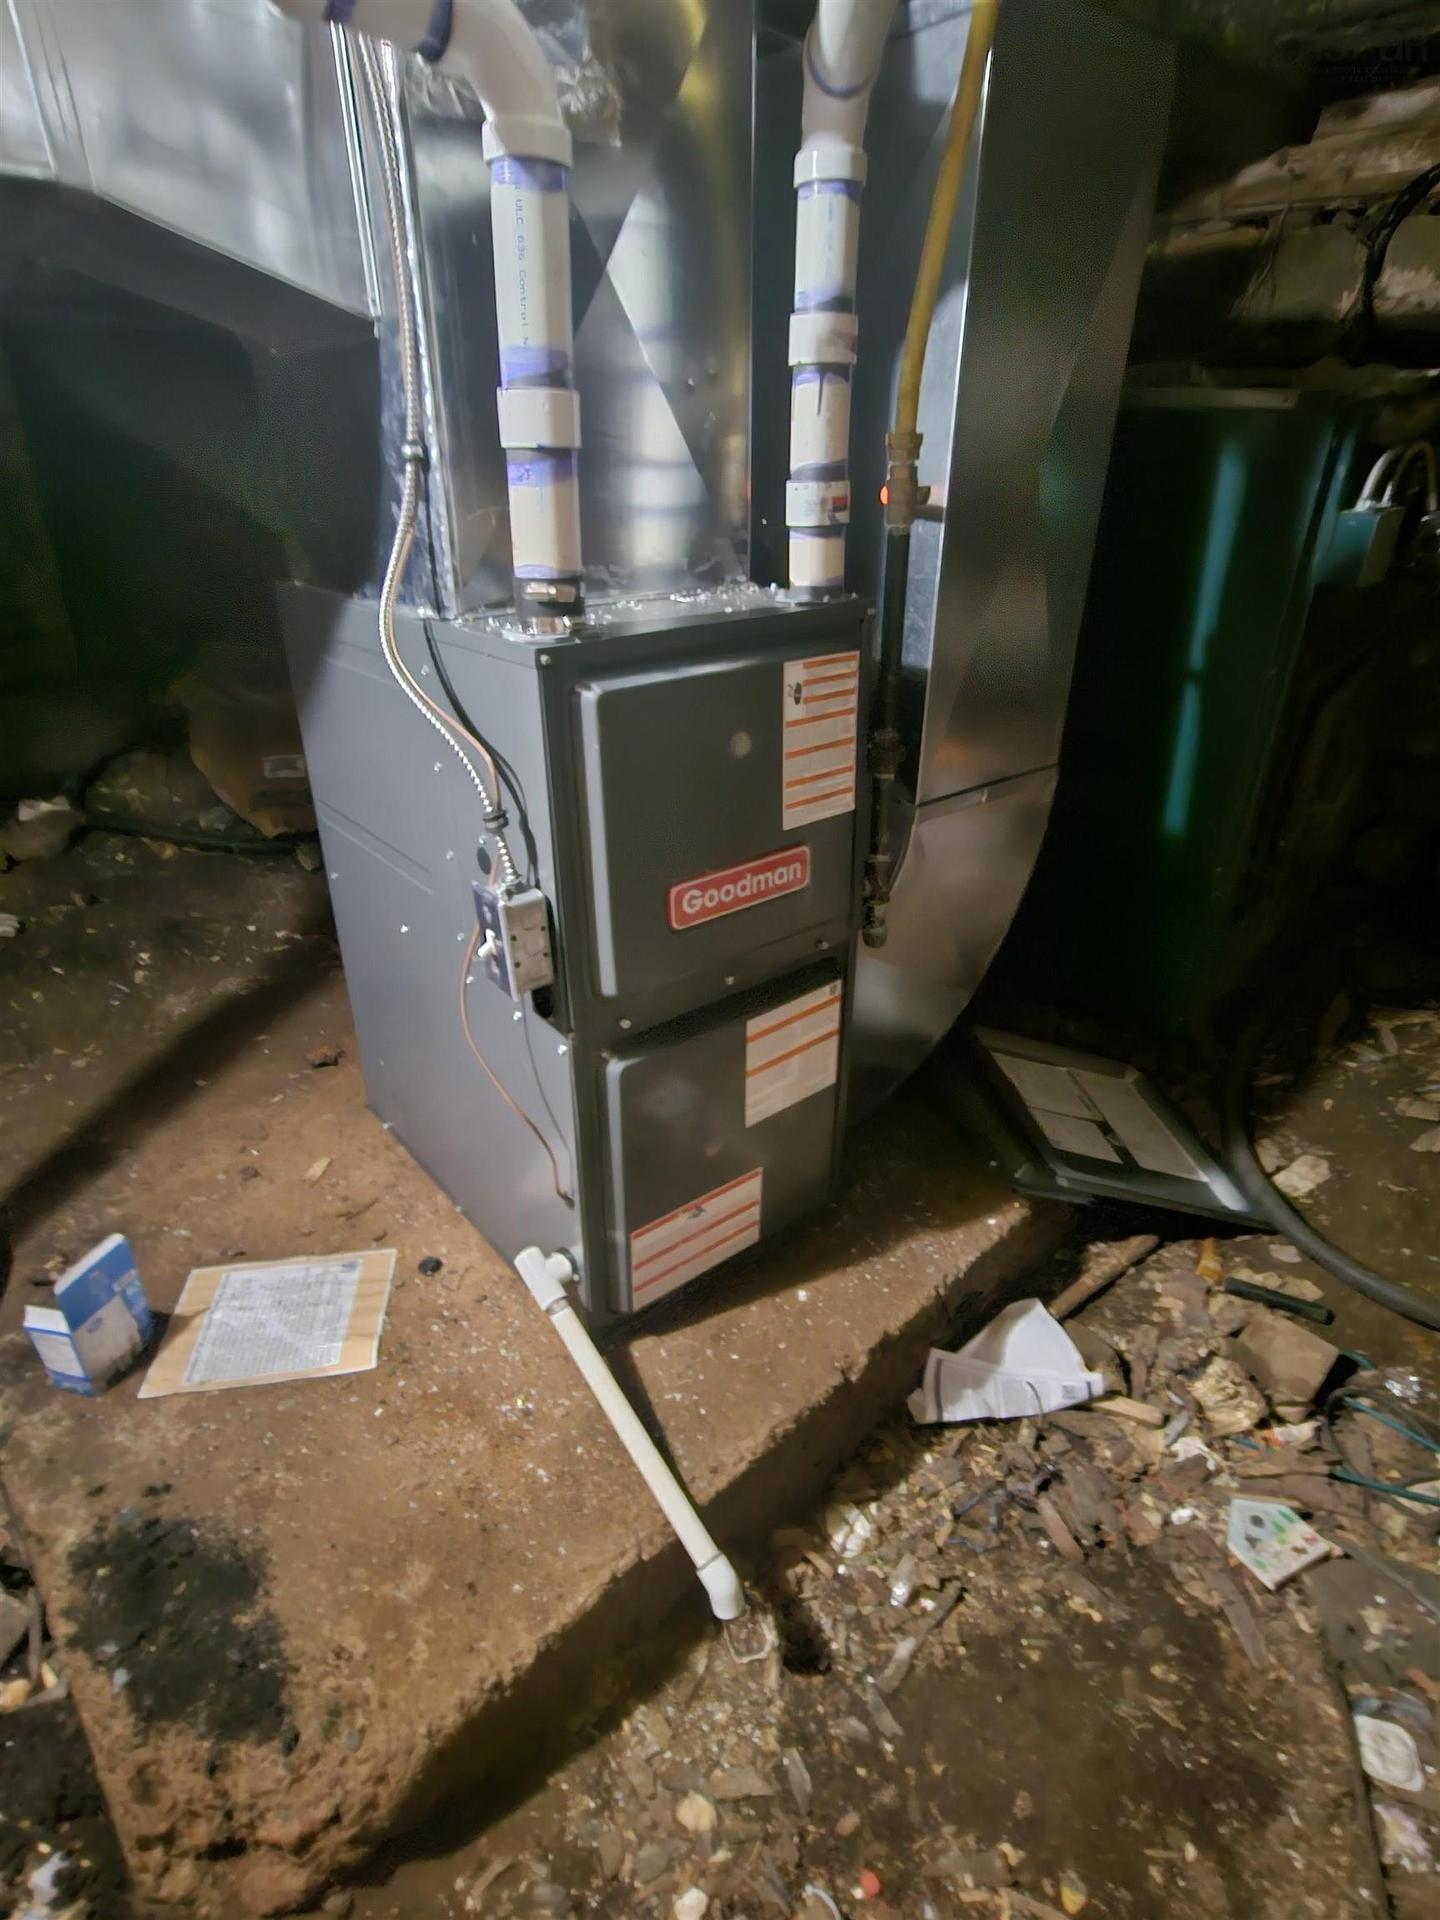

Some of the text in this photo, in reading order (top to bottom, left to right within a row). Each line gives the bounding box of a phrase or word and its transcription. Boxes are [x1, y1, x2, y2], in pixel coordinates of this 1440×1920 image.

[515, 199, 524, 225] ULC
[519, 270, 529, 327] Control
[682, 861, 801, 914] Goodman
